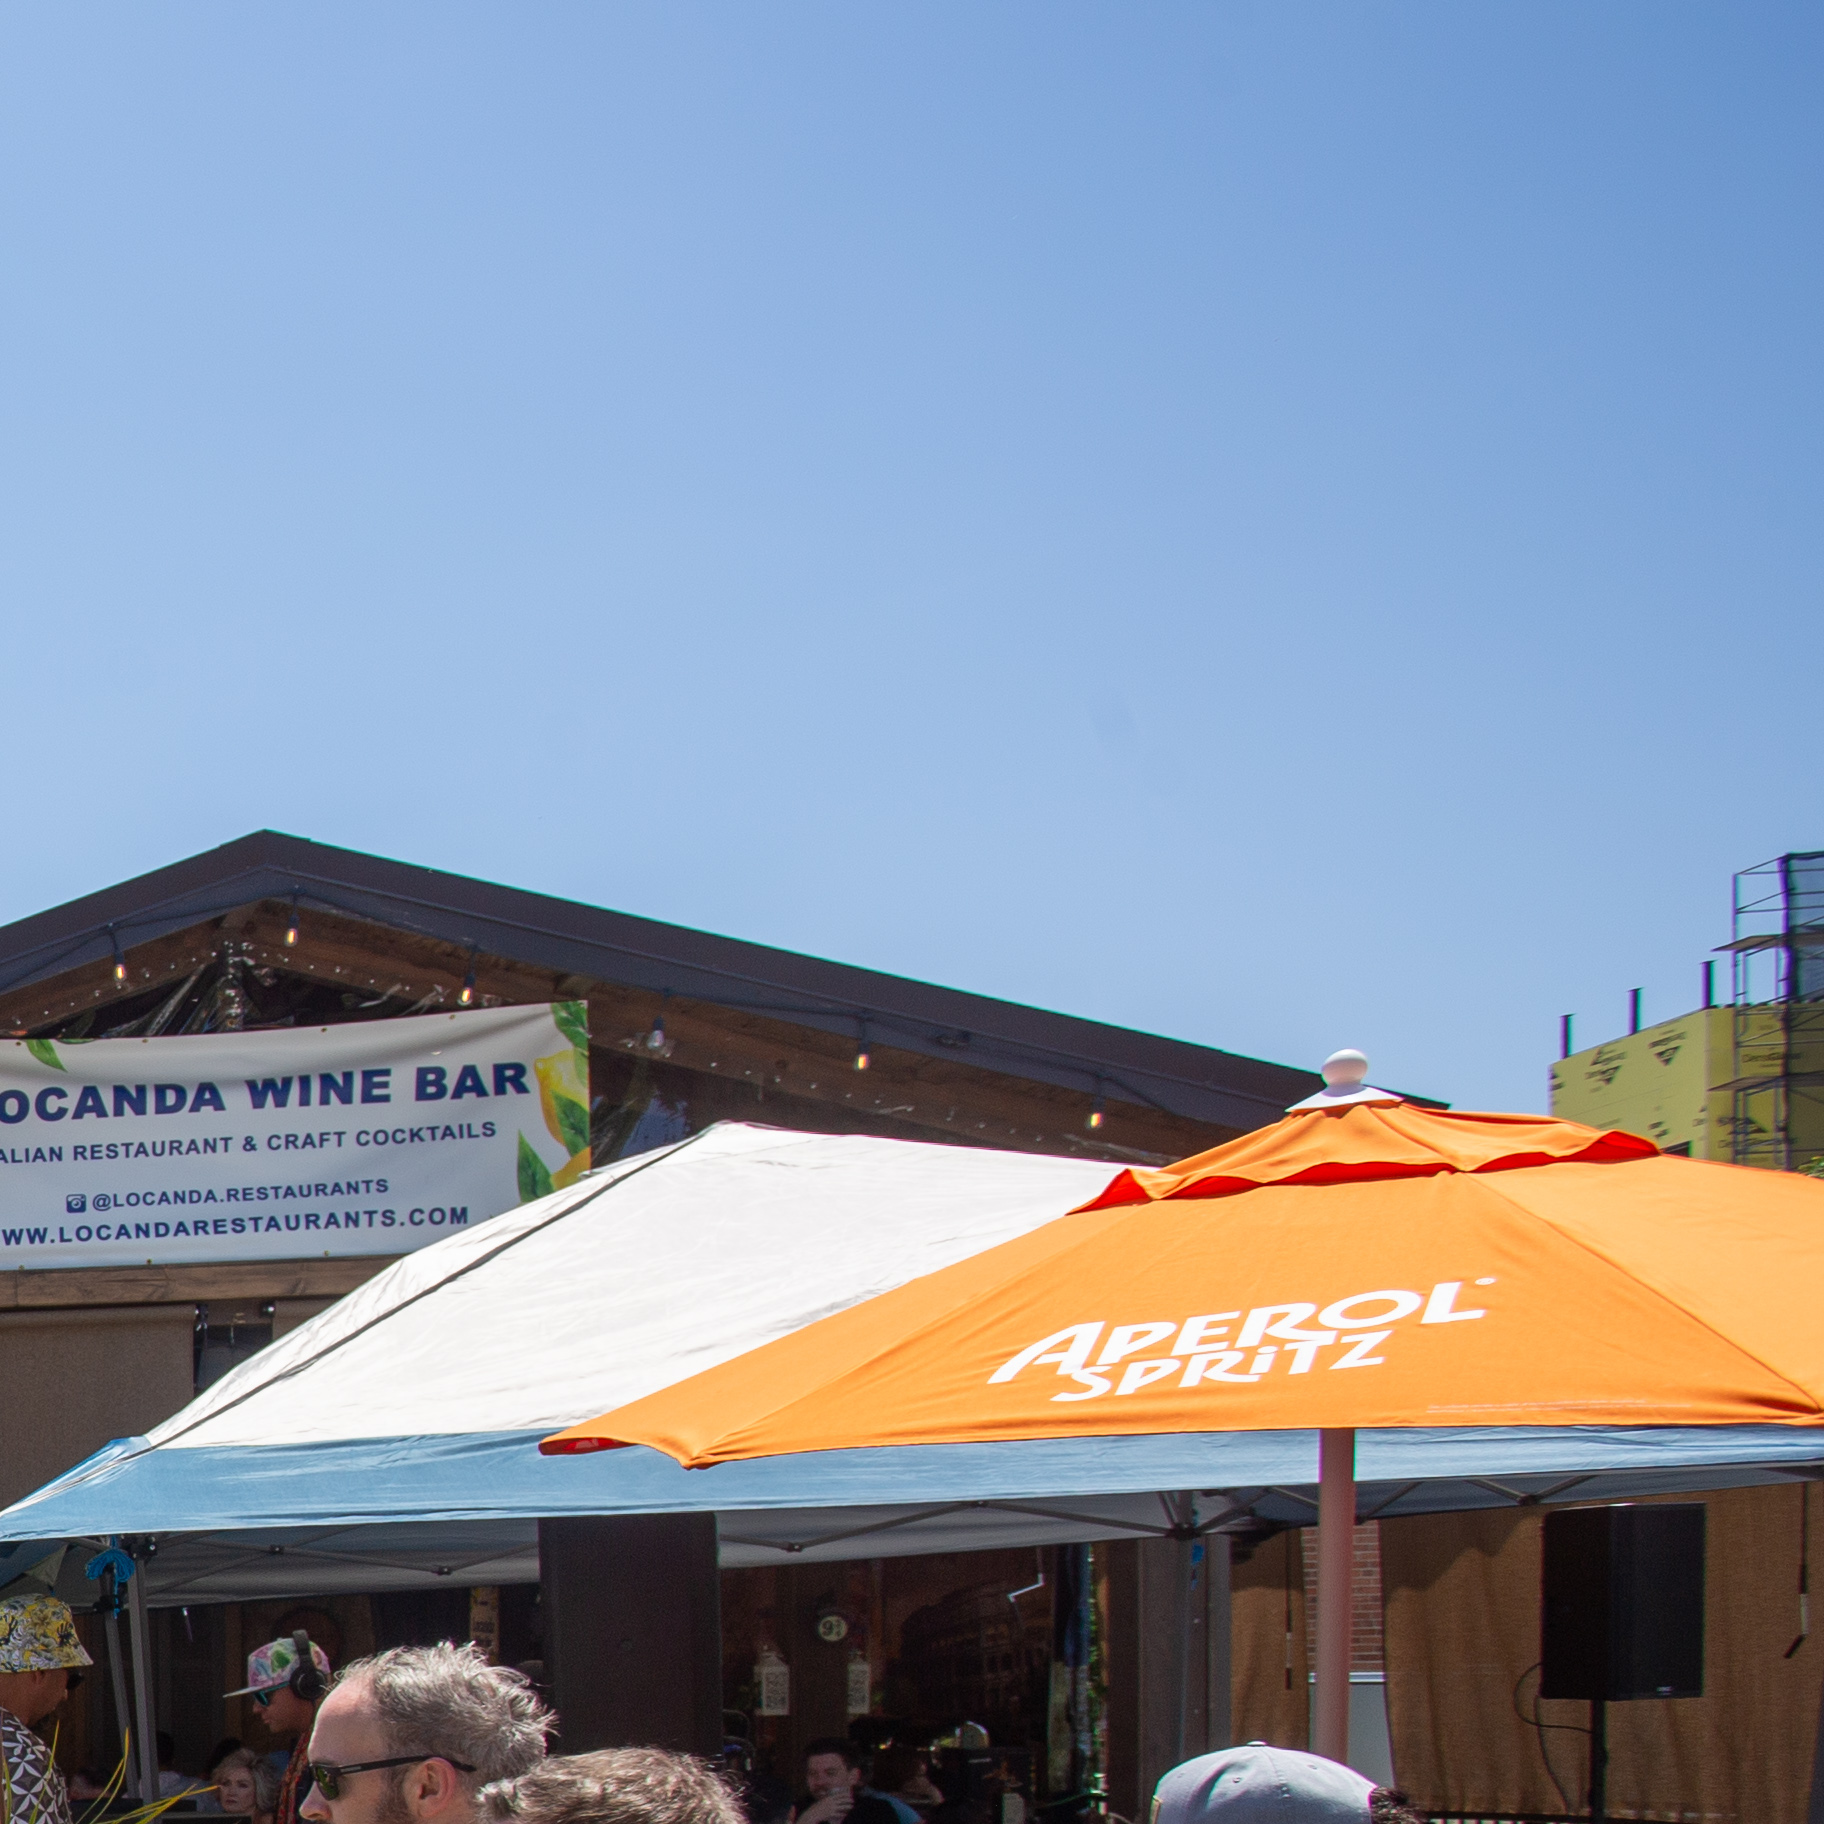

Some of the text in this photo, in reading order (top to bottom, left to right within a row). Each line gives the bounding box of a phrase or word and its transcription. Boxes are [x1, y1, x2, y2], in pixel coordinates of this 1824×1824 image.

[246, 1067, 392, 1112] WINE
[414, 1061, 531, 1103] BAR
[72, 1137, 233, 1162] RESTAURANT
[242, 1134, 260, 1153] &
[266, 1131, 348, 1152] CRAFT
[355, 1121, 498, 1148] COCKTAILS
[92, 1178, 390, 1212] @LOCANDA.RESTAURANTS
[987, 1282, 1486, 1385] APEROL
